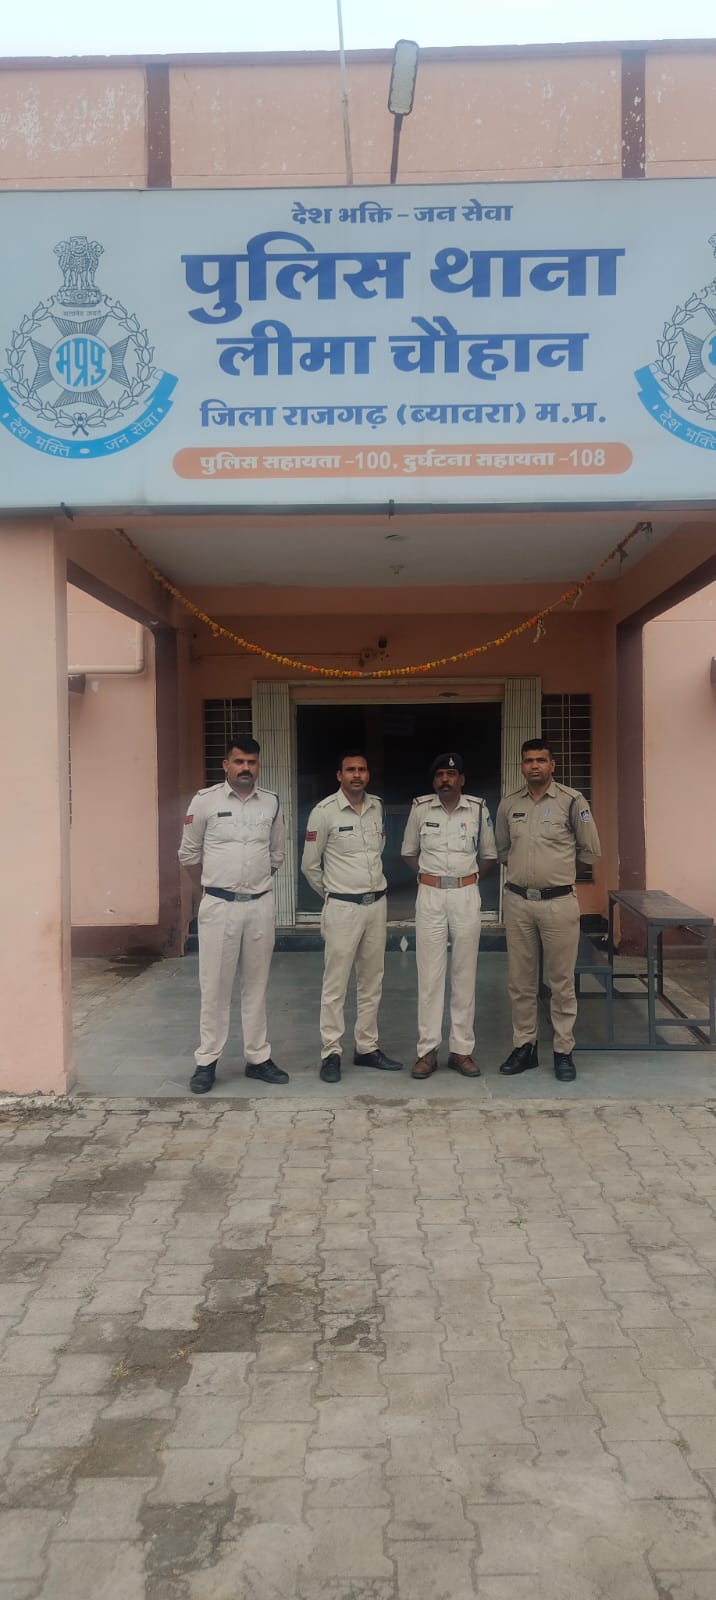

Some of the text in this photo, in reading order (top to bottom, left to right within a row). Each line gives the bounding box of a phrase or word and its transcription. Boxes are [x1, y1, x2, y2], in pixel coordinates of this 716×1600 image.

[291, 202, 333, 224] देश
[339, 201, 393, 223] भक्ति
[414, 206, 457, 222] जन
[462, 199, 514, 222] सेवा
[181, 231, 626, 324] पुलिस थाना
[216, 316, 590, 381] लीमा चौहान
[200, 398, 606, 430] जिला राजगढ़ (ब्यावरा) म.प्र.
[659, 408, 682, 433] देश
[10, 412, 160, 457] देश भक्ति जन सेवा
[200, 452, 258, 475] पुलिस
[263, 454, 341, 470] सहायता
[403, 449, 472, 473] दुर्घटना
[476, 452, 556, 469] सहायता
